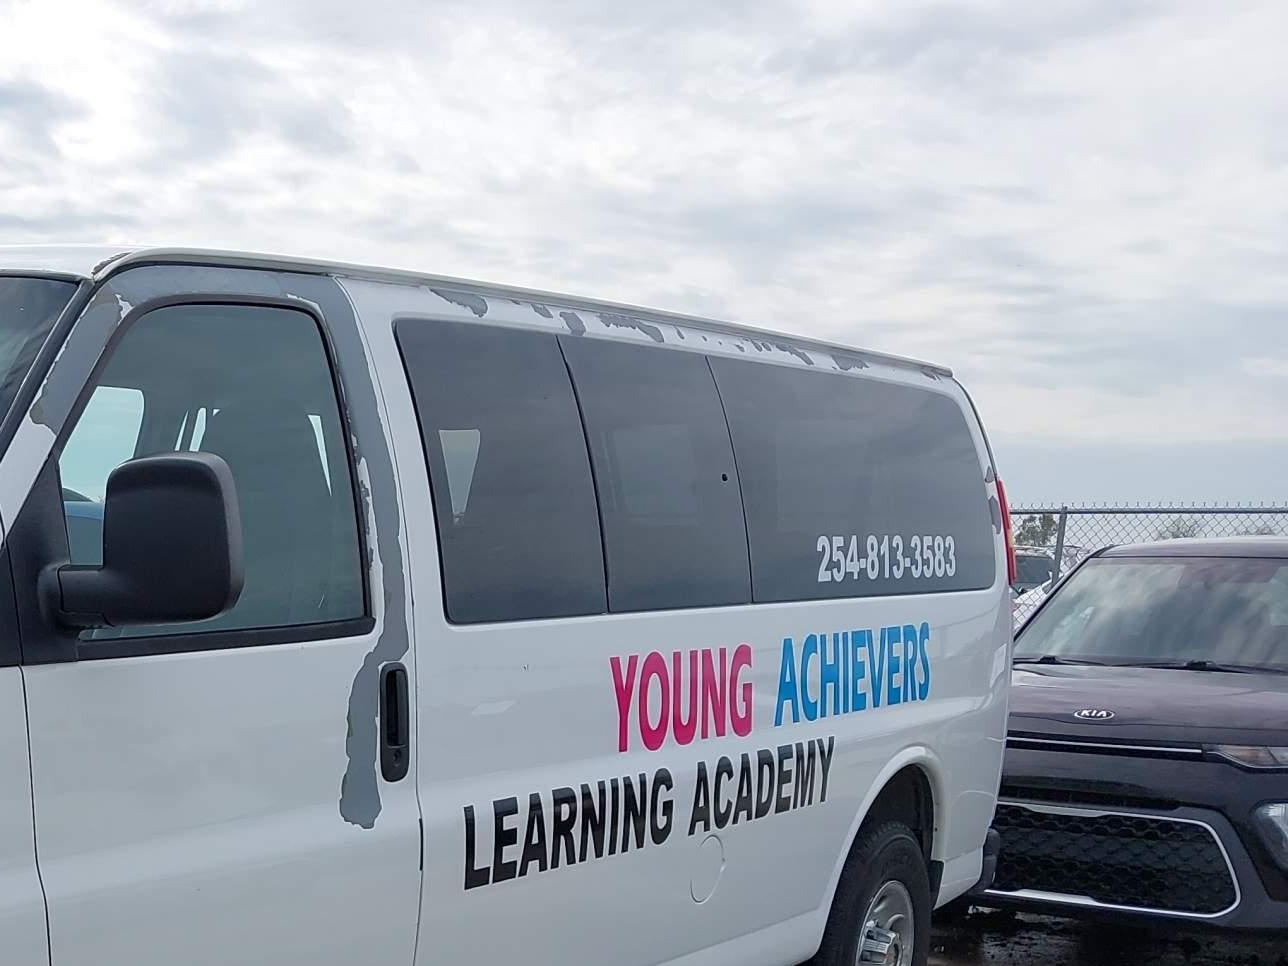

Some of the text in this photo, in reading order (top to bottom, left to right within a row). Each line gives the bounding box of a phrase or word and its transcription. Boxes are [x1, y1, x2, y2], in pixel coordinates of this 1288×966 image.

[817, 535, 956, 582] 254-813-3583
[610, 622, 930, 752] YOUNG ACHIEVERS
[1080, 709, 1107, 718] KIA
[463, 735, 835, 891] LEARNING ACADEMY
